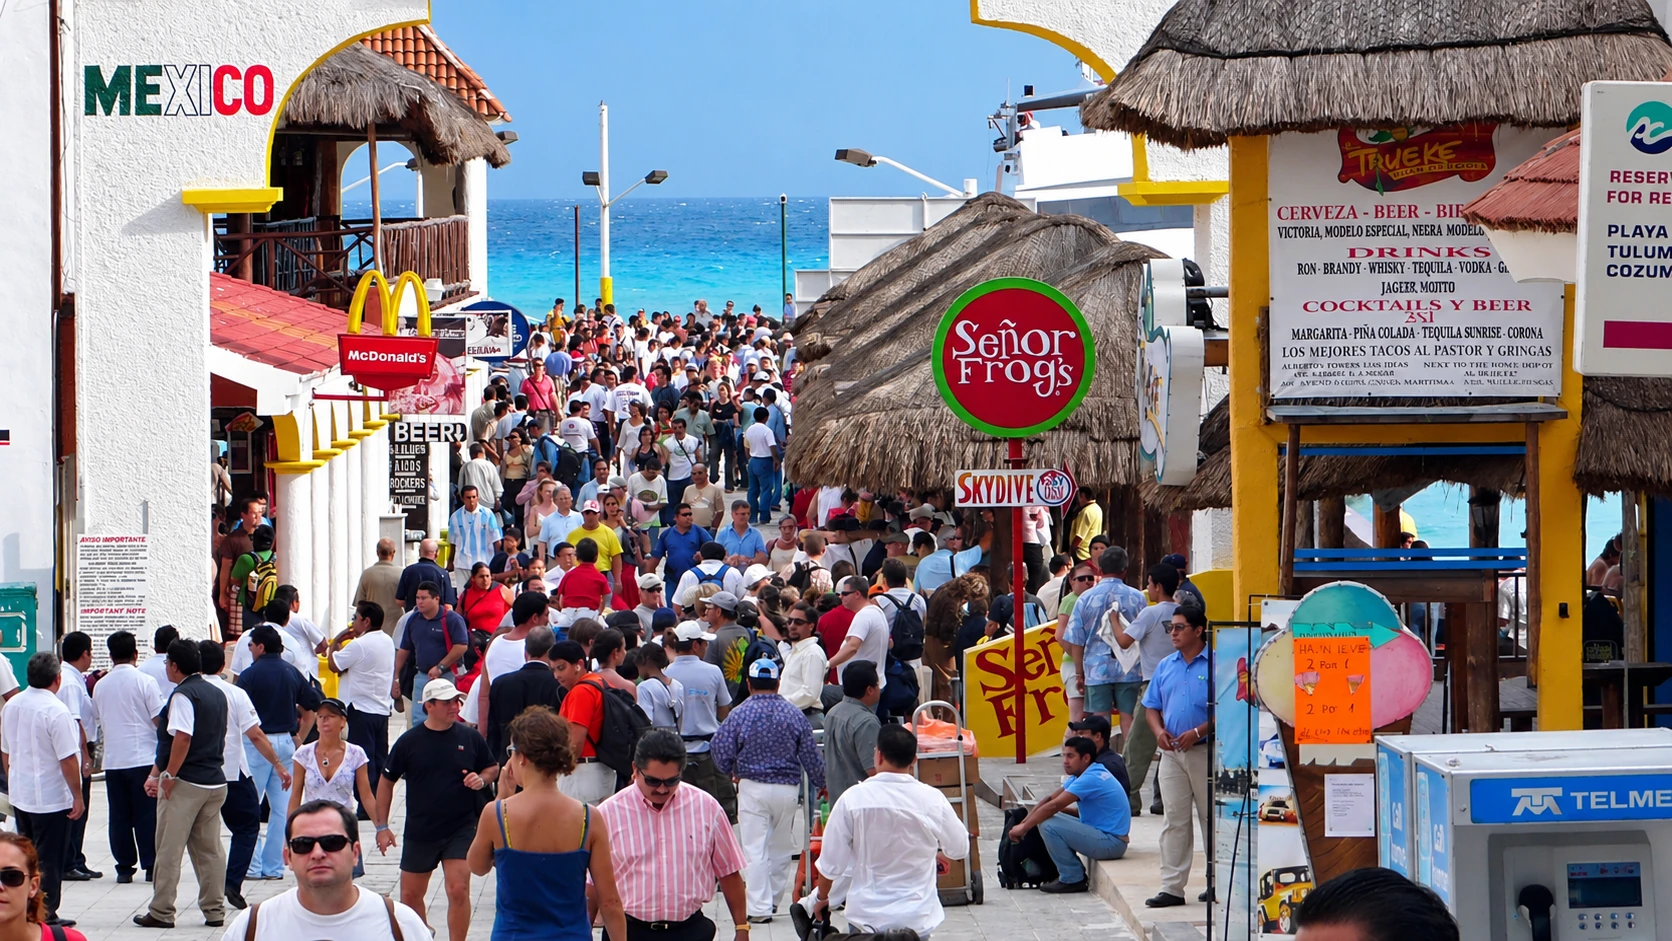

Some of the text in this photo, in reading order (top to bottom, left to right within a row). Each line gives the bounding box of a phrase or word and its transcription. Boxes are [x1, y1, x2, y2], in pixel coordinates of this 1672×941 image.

[84, 64, 274, 116] MEXICO
[1349, 140, 1463, 177] TRUEKE
[1607, 190, 1643, 204] FOR
[1277, 204, 1358, 220] CERVEZA
[1374, 203, 1420, 219] BEER
[1278, 226, 1322, 240] VICTORIA,
[1325, 224, 1364, 238] MODELO
[1365, 223, 1410, 239] ESPECIAL,
[1607, 224, 1668, 239] PLAYA
[1347, 246, 1491, 258] DRINKS
[1608, 245, 1672, 259] TULUM
[1297, 263, 1317, 275] RON
[1323, 262, 1361, 275] BRANDY
[1368, 261, 1405, 274] WHISKY
[1412, 261, 1452, 277] TEQUILA
[1459, 261, 1492, 274] VODKA
[1303, 300, 1532, 313] COCKTAILS Y BEER
[952, 319, 1076, 359] Señor
[1292, 328, 1348, 340] MARGARITA
[1378, 326, 1415, 339] COLADA
[1422, 326, 1463, 341] TEQUILA
[1464, 326, 1501, 339] SUNRISE
[1507, 326, 1543, 339] CORONA
[348, 350, 427, 364] McDonald's
[1282, 345, 1552, 358] LOS MEJORES TACOS AL PASTOR Y GRINGAS
[957, 356, 1074, 398] Frog's
[395, 422, 455, 442] BEER
[957, 472, 1034, 504] SKYDIVE
[975, 627, 1060, 697] Señ
[1307, 659, 1315, 670] 2
[1306, 703, 1315, 715] 2
[1570, 790, 1672, 810] TELME
